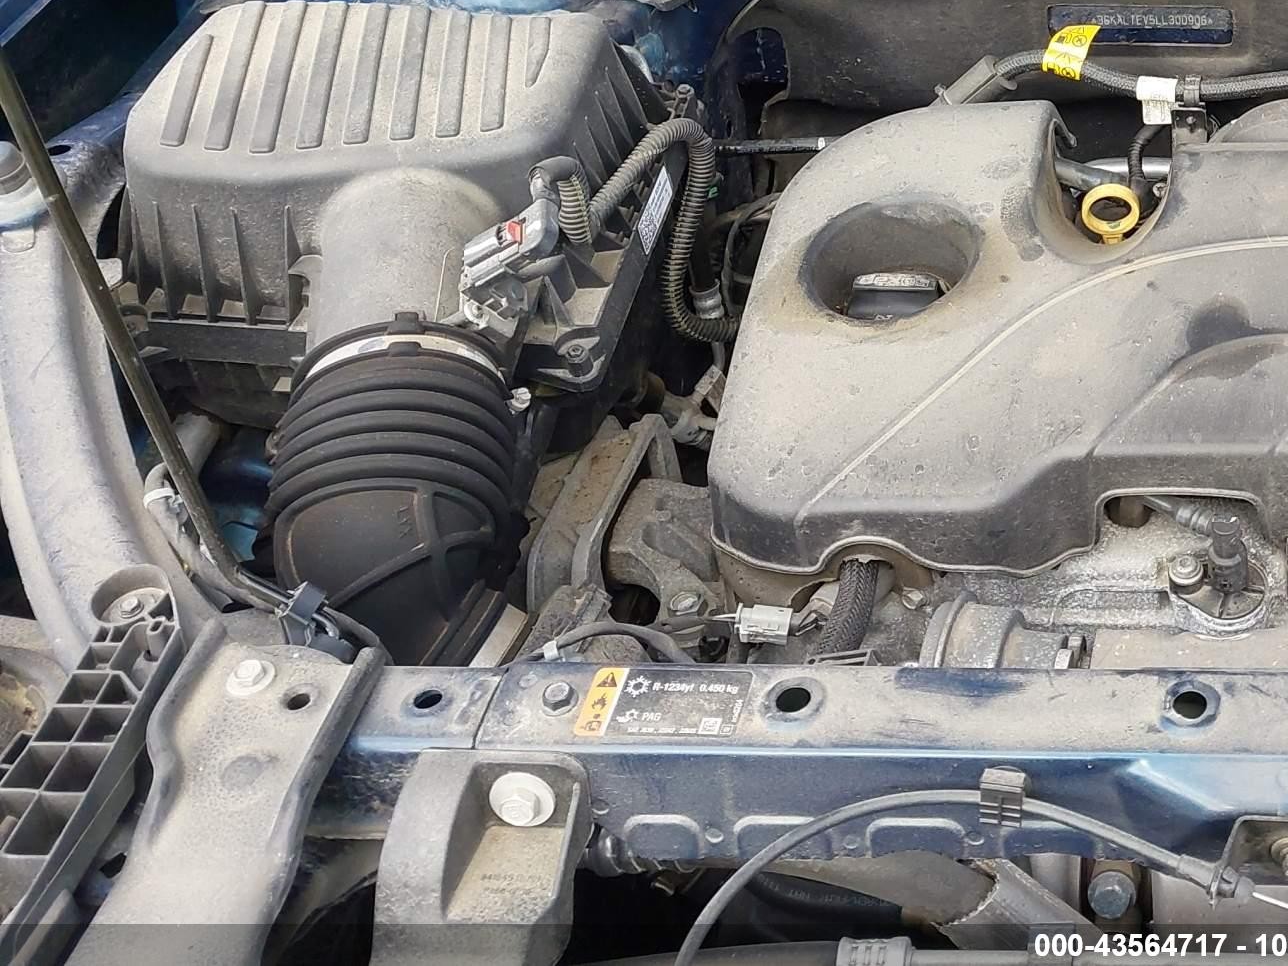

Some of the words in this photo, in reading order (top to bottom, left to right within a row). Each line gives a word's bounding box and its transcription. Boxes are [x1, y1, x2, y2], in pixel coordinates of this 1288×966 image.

[699, 683, 725, 693] 0.450
[726, 684, 739, 694] kg
[641, 712, 662, 722] PAG
